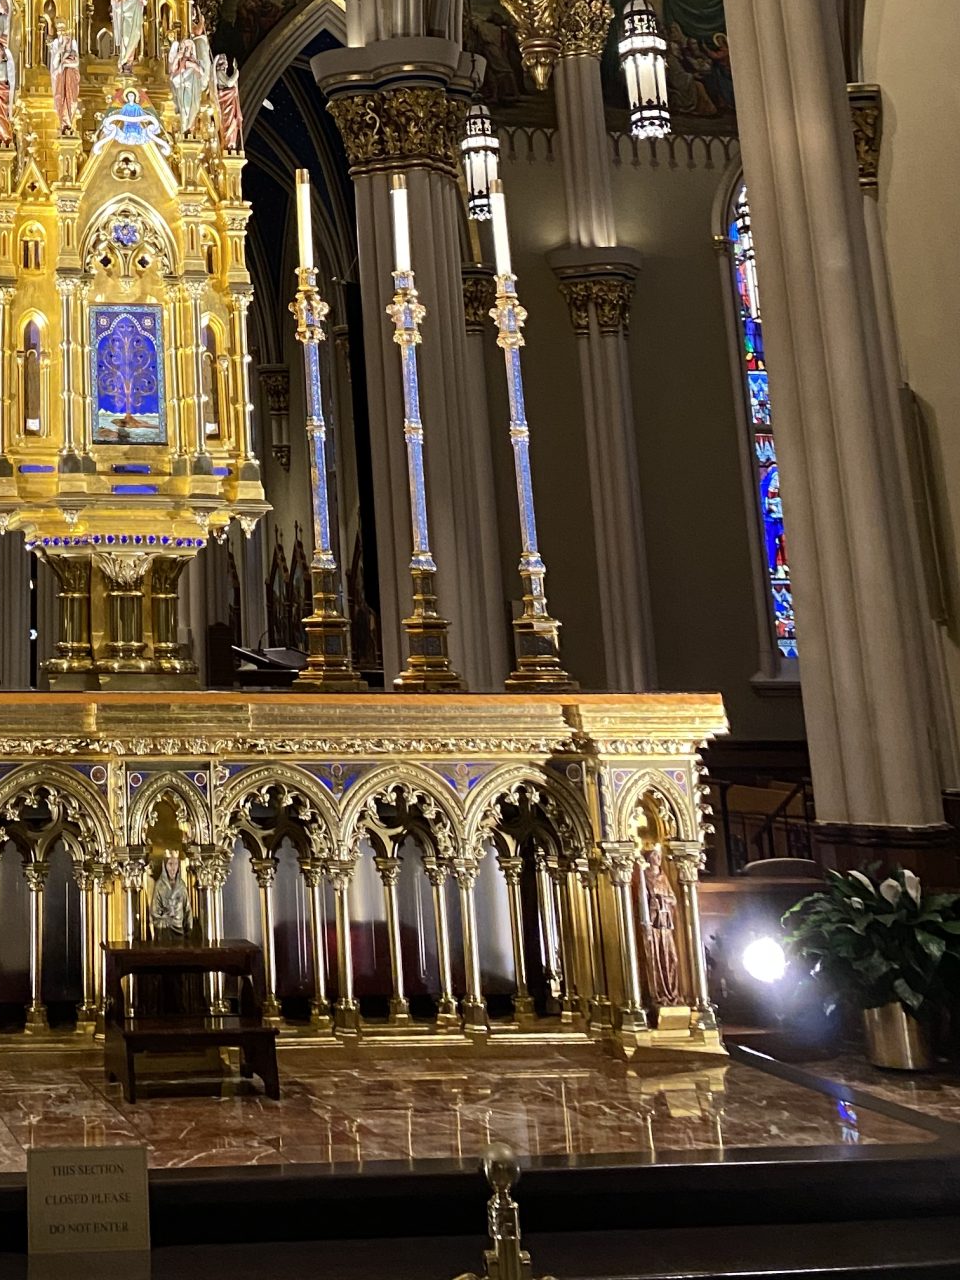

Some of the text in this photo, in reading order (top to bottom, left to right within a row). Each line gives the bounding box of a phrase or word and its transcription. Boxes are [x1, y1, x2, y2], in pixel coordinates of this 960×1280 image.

[52, 1165, 124, 1176] THIS SECTION
[45, 1193, 131, 1205] CLOSED PLEASE
[49, 1222, 129, 1234] DO NOT ENTER
